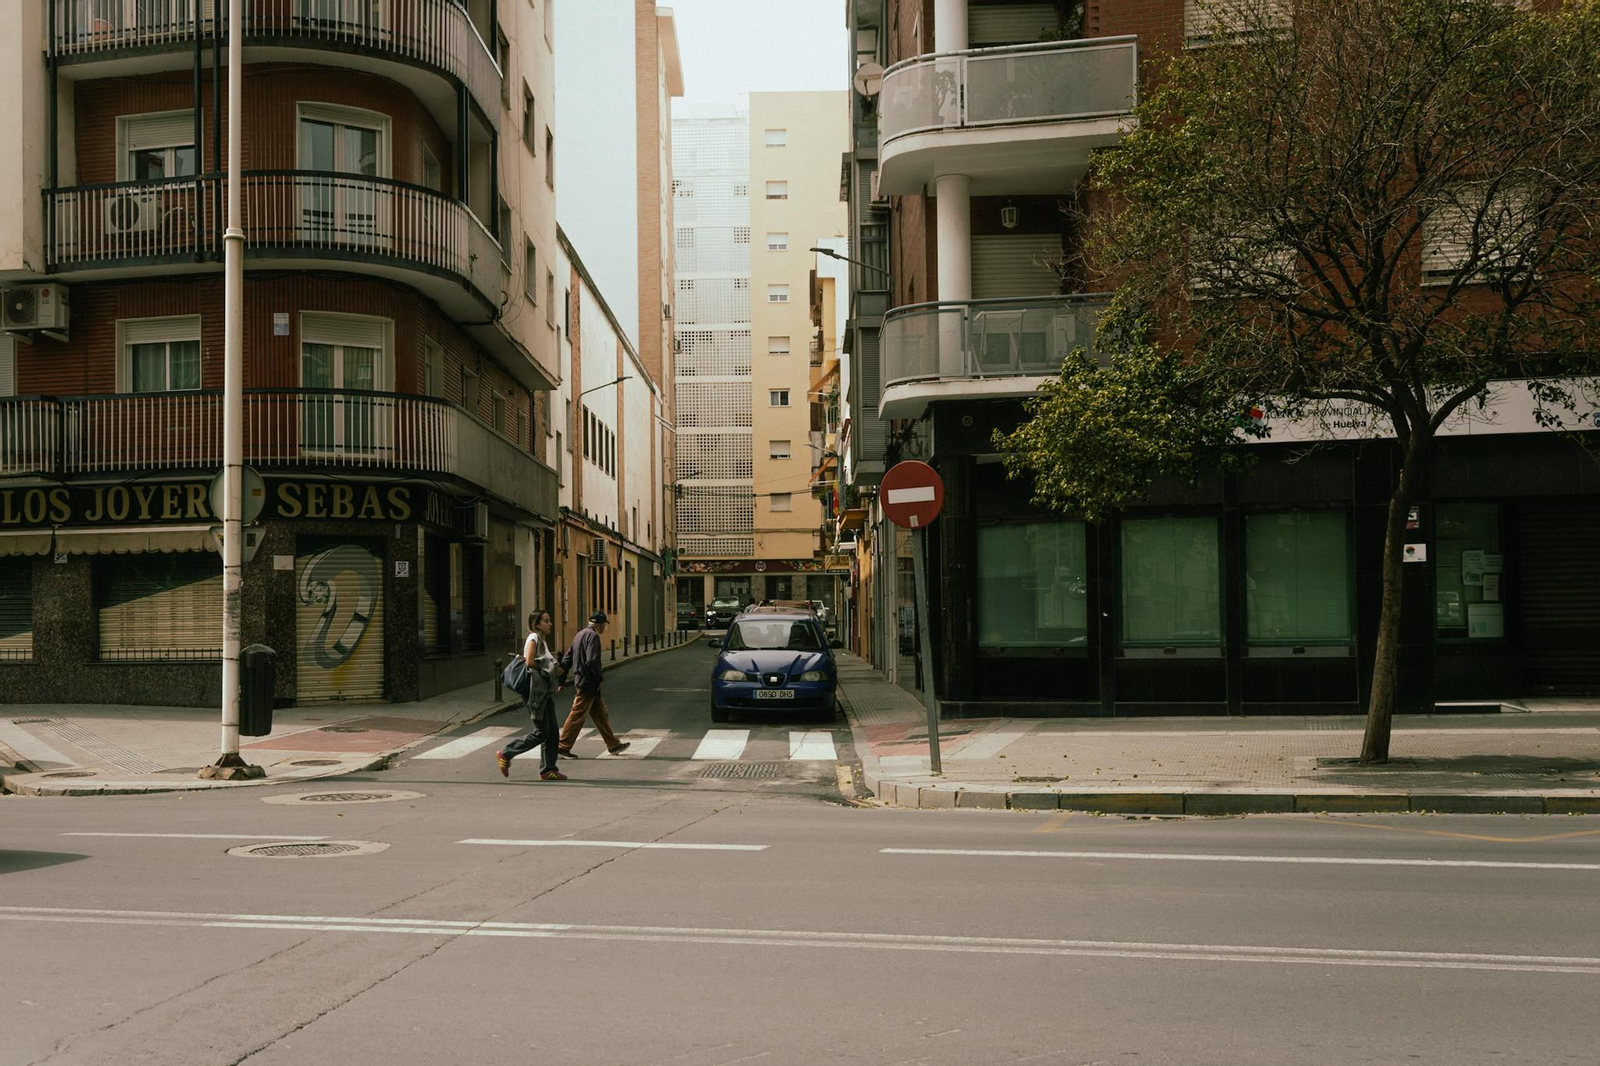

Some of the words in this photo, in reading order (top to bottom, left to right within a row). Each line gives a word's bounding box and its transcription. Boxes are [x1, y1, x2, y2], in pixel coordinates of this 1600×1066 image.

[1307, 406, 1364, 418] PROVINCIAL
[1320, 420, 1331, 429] de
[1333, 419, 1367, 429] Huelva
[2, 488, 72, 525] LOS
[84, 483, 216, 521] JOYER
[276, 481, 413, 521] SEBAS
[425, 488, 455, 530] JOYERI
[779, 690, 793, 698] DHS
